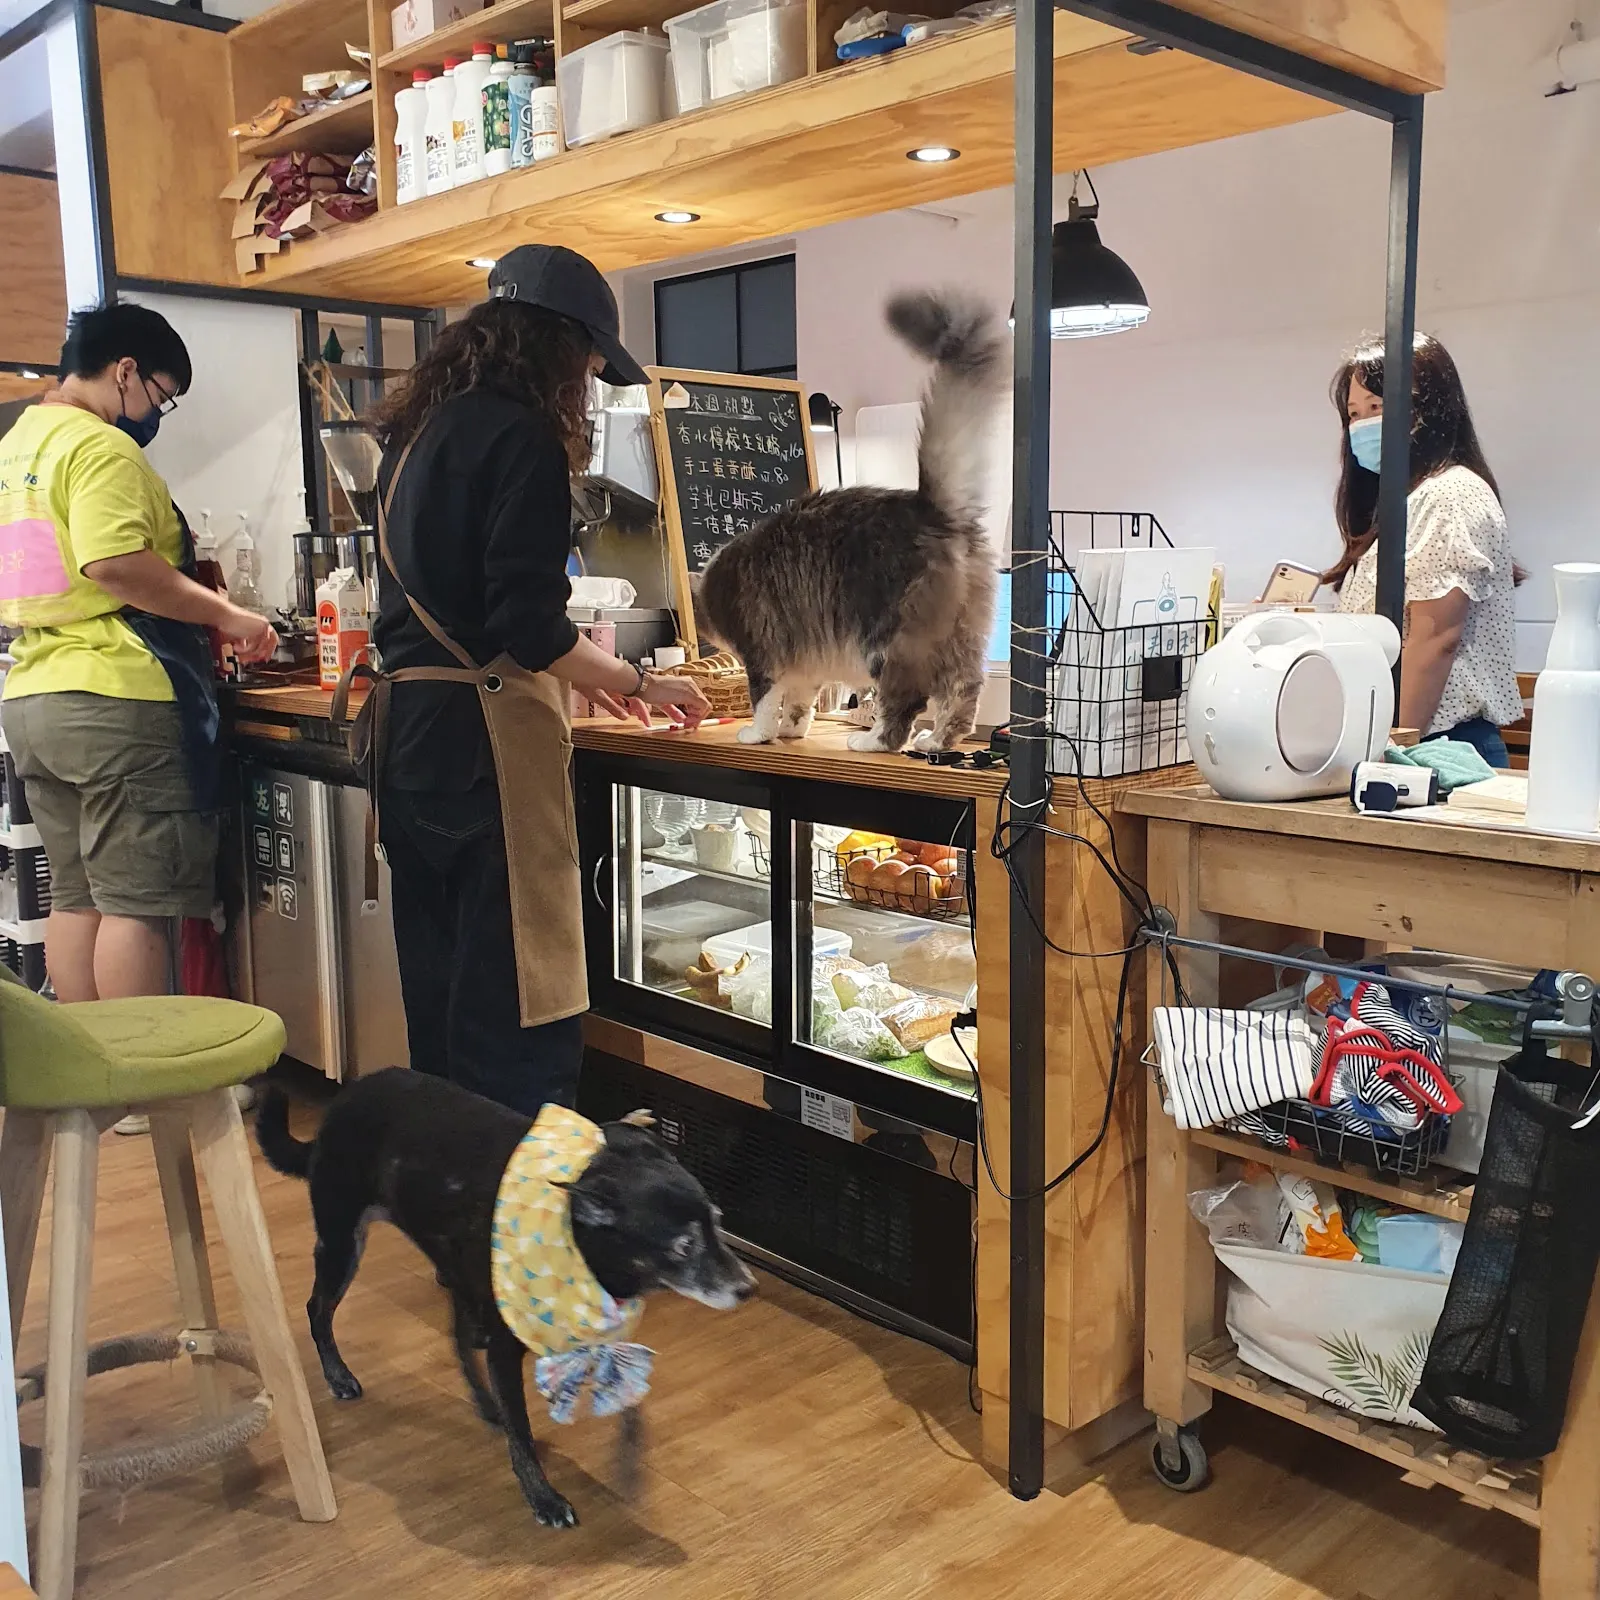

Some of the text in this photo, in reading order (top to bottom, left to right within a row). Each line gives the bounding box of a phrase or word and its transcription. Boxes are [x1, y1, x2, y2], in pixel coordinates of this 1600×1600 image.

[676, 422, 780, 456] 香水檸檬生乳酪
[684, 456, 758, 481] 手工蛋黃酥
[688, 484, 768, 514] 芋泥巴斯克
